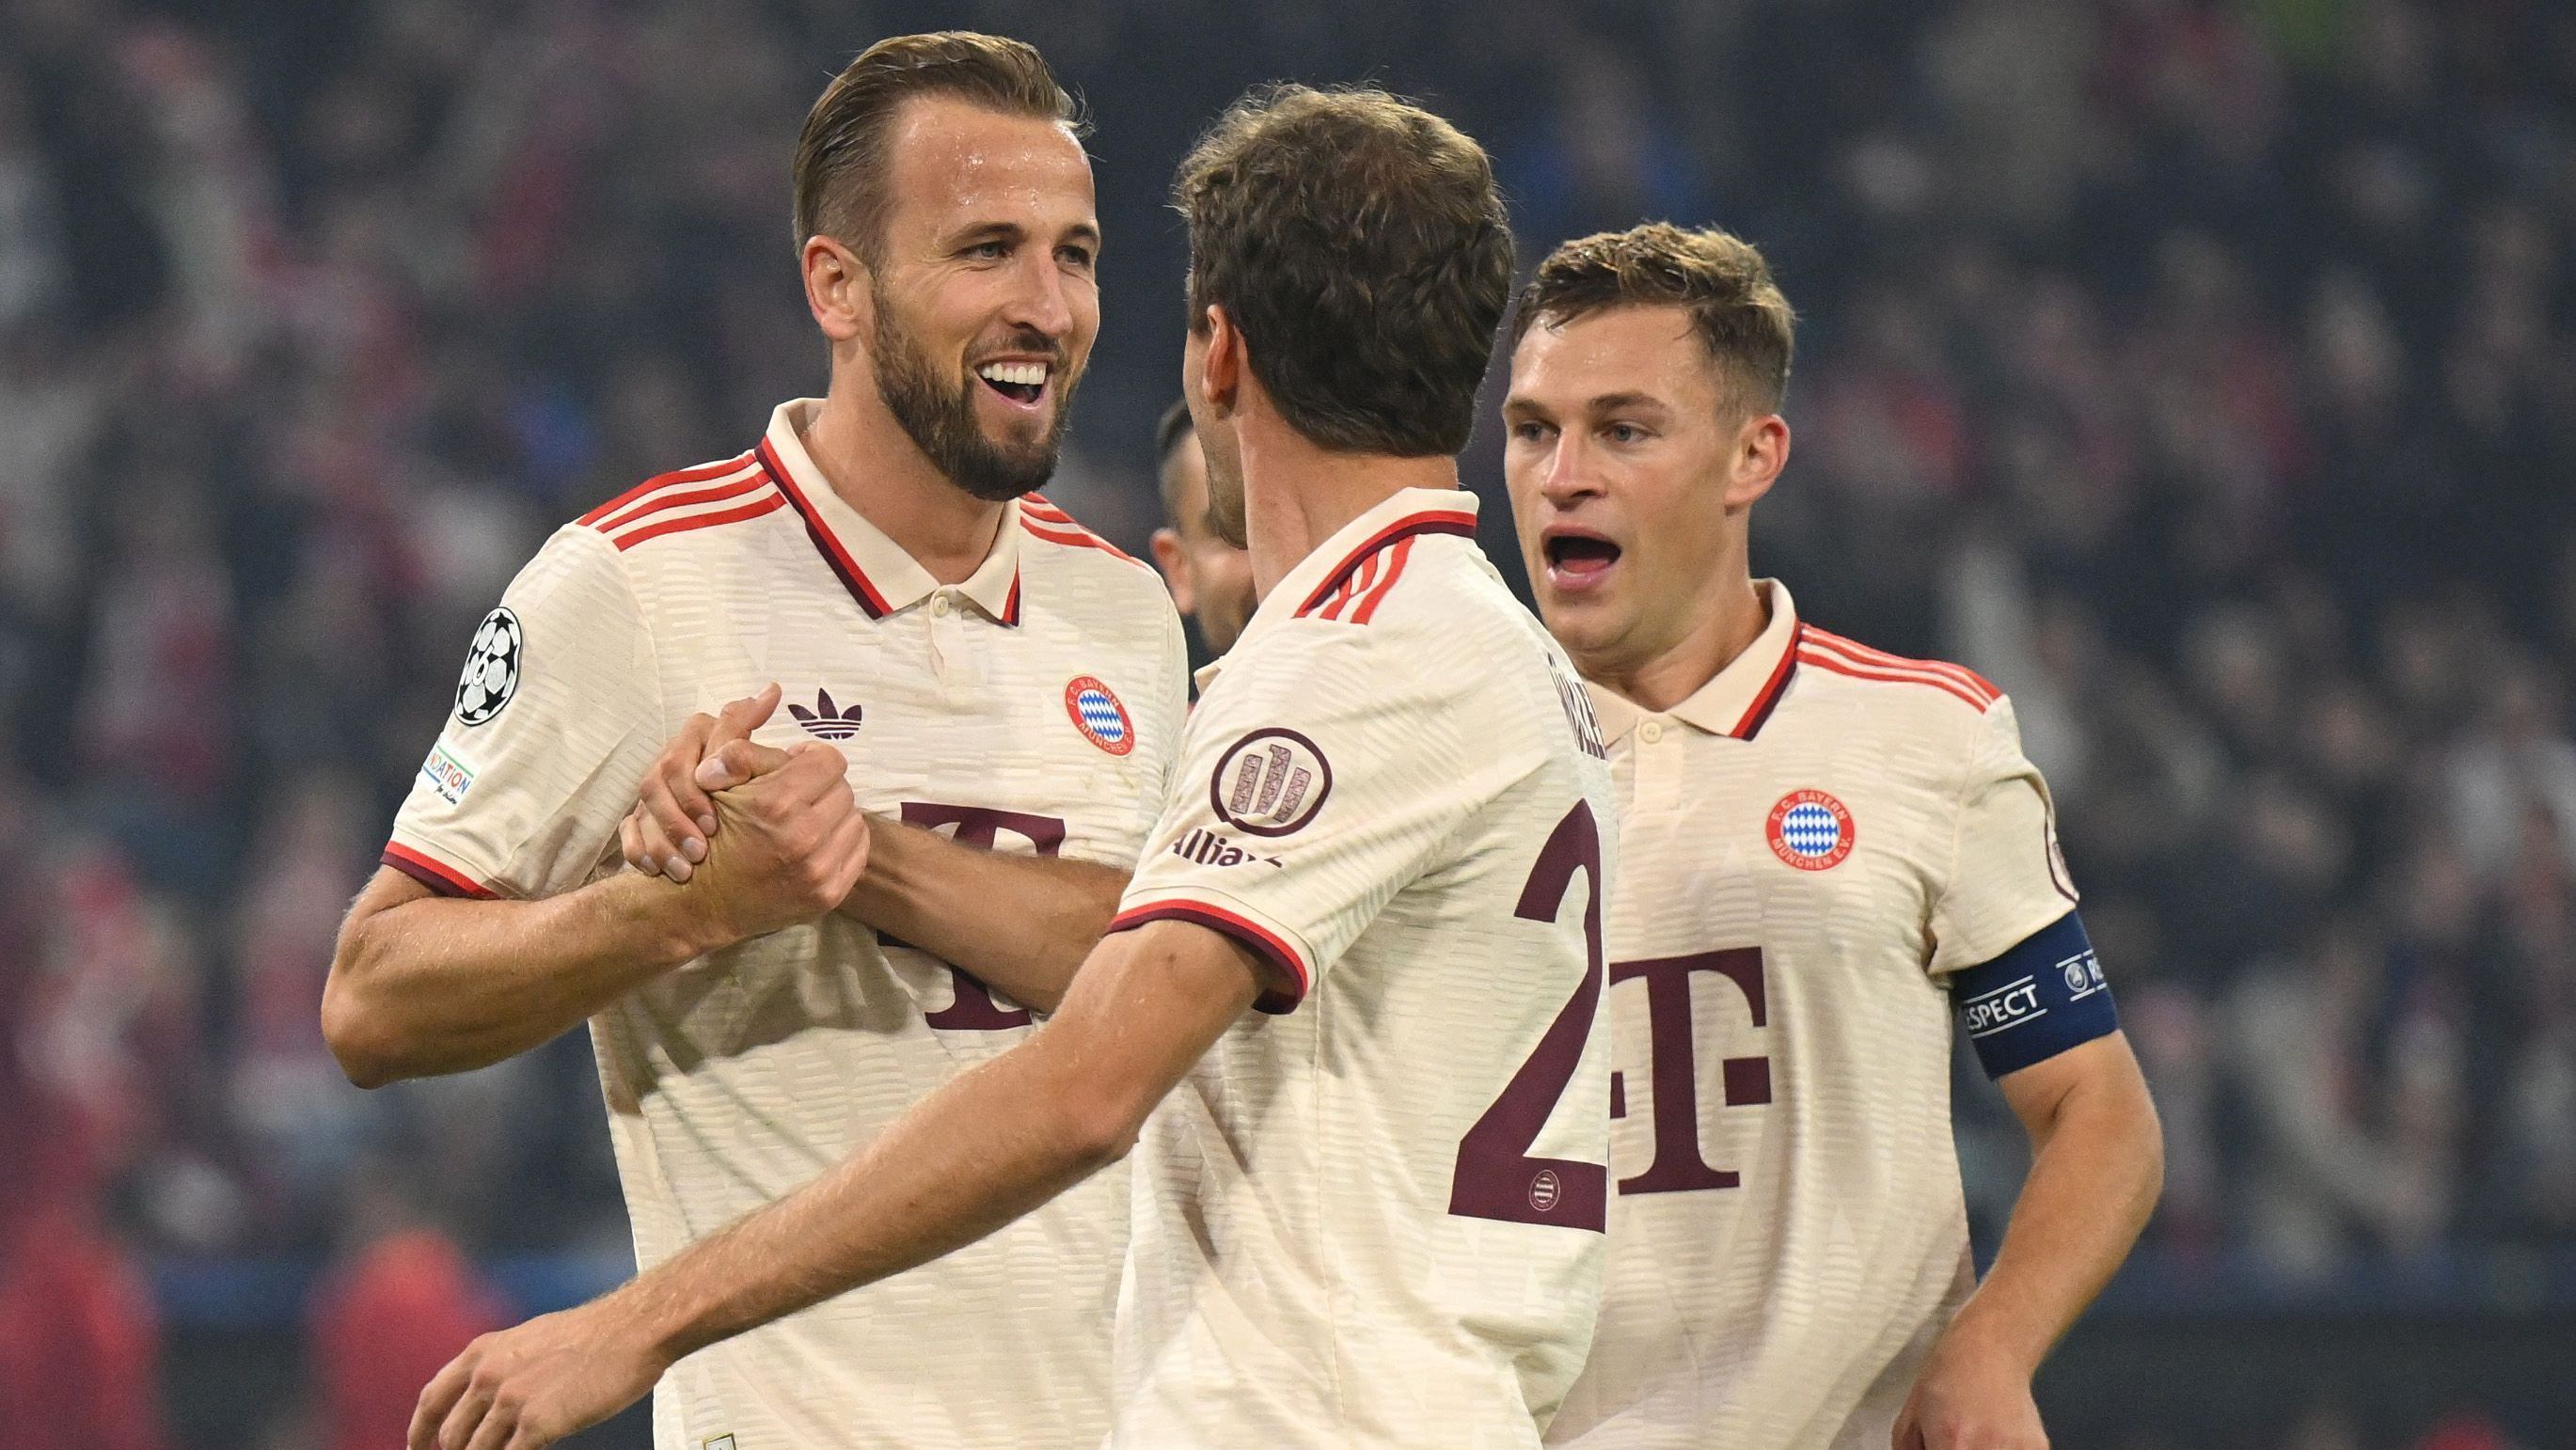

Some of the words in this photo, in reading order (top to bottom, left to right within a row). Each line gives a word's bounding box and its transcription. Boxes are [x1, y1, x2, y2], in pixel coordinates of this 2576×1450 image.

[1078, 678, 1120, 707] BAYERN
[1797, 791, 1848, 821] BAYERN
[1967, 984, 2037, 1031] SPECT
[1609, 946, 1772, 1195] T
